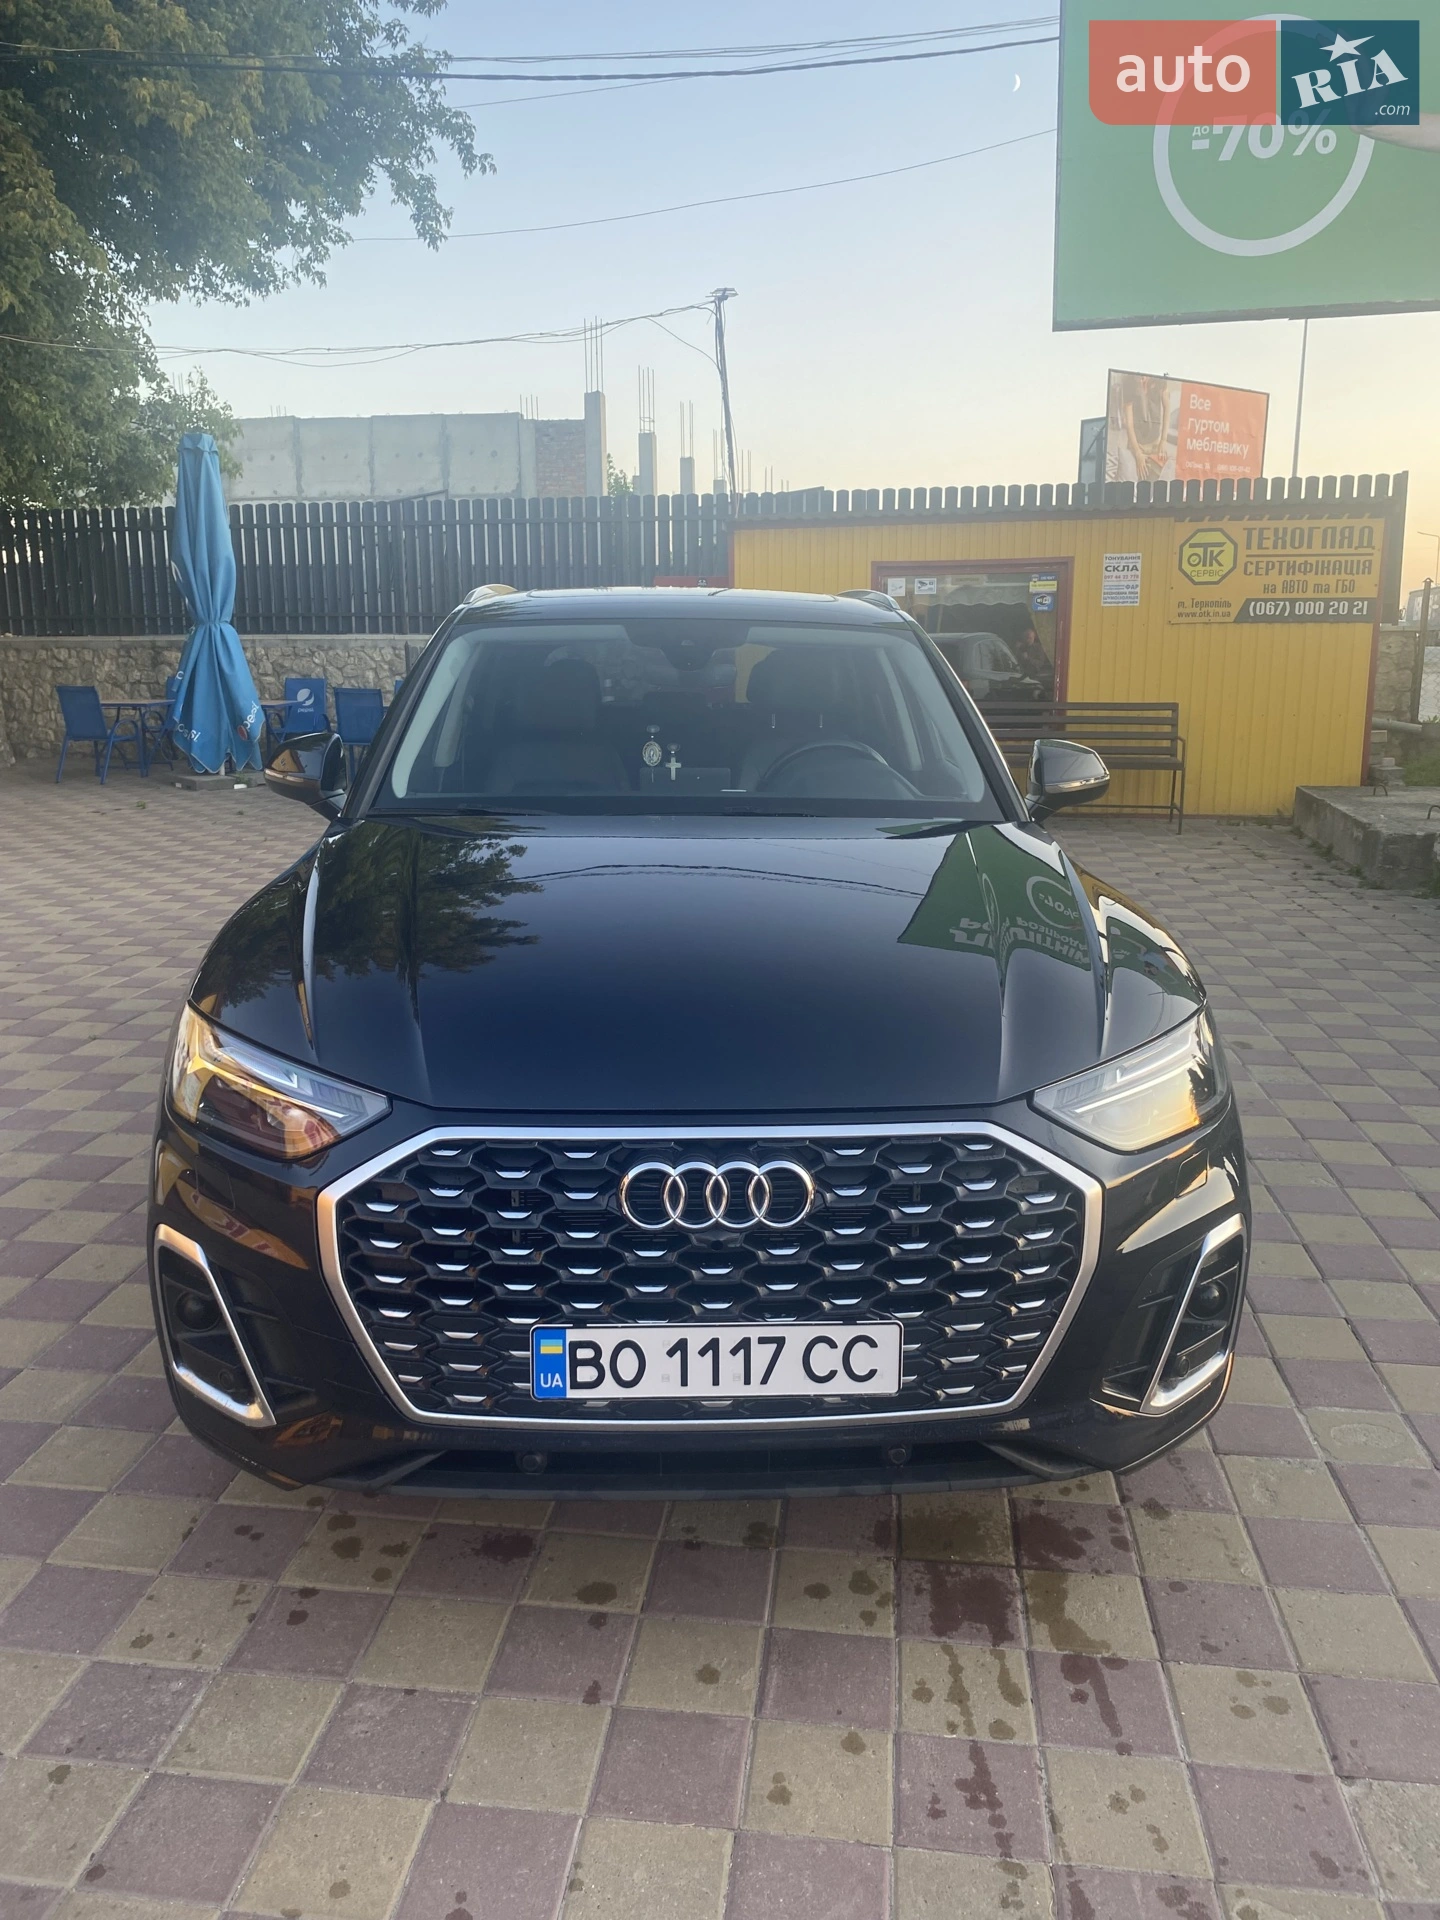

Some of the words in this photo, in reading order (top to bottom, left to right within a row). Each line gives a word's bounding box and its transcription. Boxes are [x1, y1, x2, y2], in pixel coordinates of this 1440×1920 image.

[1189, 393, 1211, 411] Все
[1187, 417, 1230, 435] гуртом
[1186, 437, 1249, 460] меблевику
[1243, 526, 1375, 550] ТЕХОГЛЯД
[1104, 564, 1140, 572] СКЛА
[1189, 569, 1224, 578] СЕРВІС
[1243, 559, 1373, 576] СЕРТИФІКАЦІЯ
[1263, 583, 1277, 594] на
[1281, 580, 1309, 594] АВТО
[1312, 583, 1331, 594] та
[1335, 579, 1356, 594] ГБО
[1190, 598, 1232, 611] Тернопіль
[1249, 601, 1291, 616] (067)
[1294, 601, 1325, 615] 000
[1328, 601, 1349, 615] 20
[1352, 601, 1368, 615] 21
[1177, 609, 1231, 618] www.otk.in.ua
[568, 1339, 647, 1391] BO
[665, 1335, 787, 1388] 1117
[801, 1333, 879, 1384] CC
[540, 1372, 564, 1389] UA
